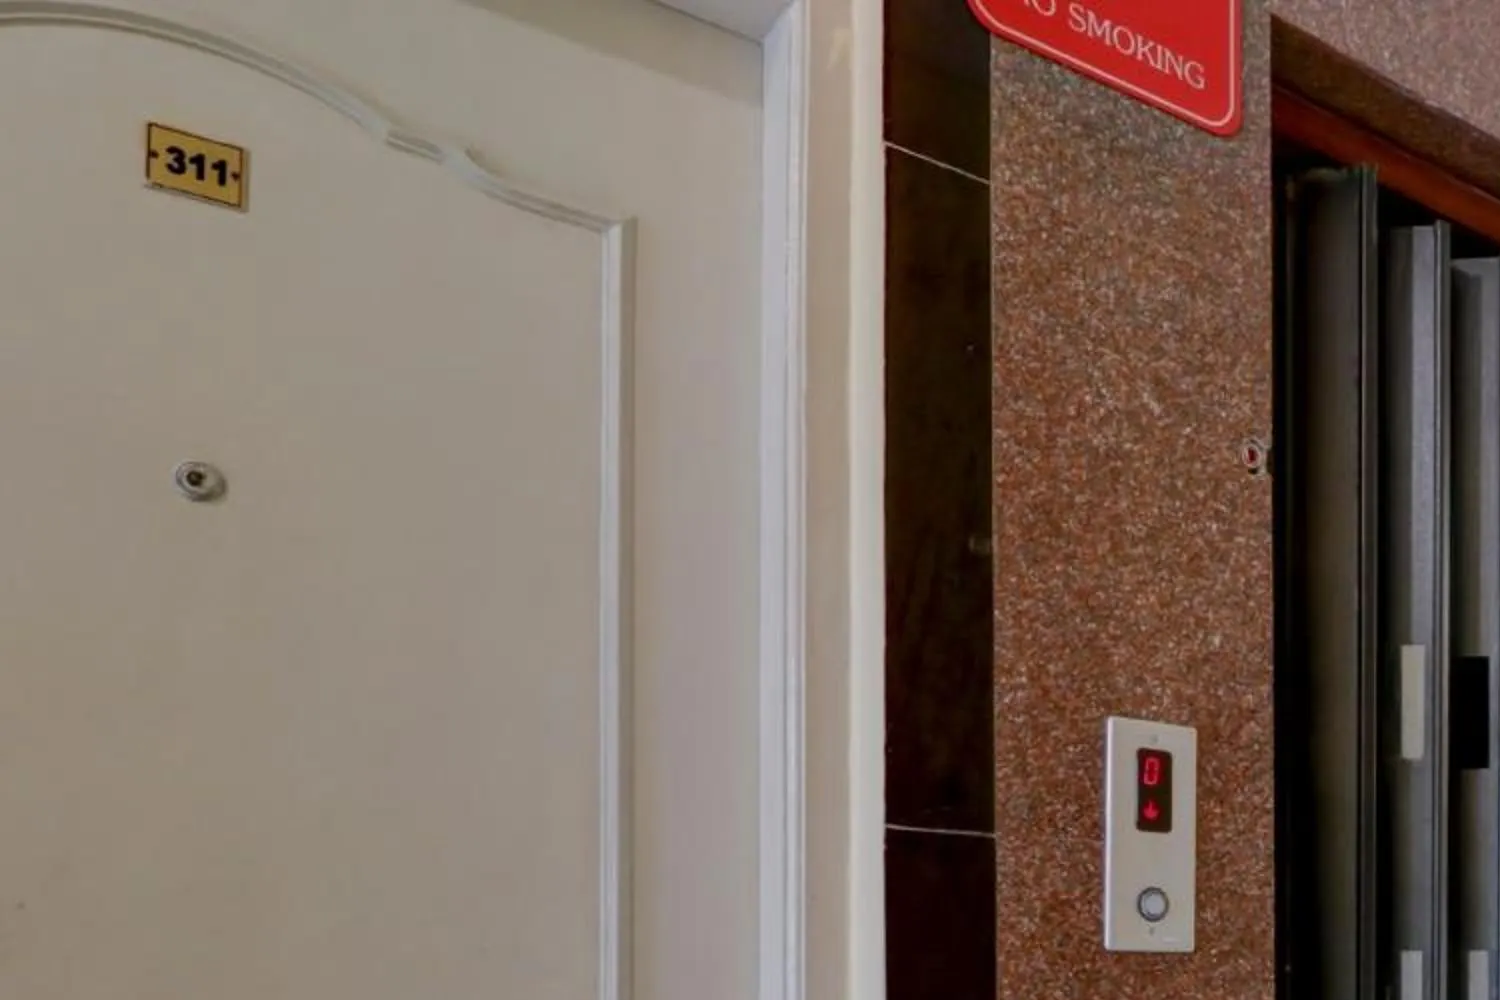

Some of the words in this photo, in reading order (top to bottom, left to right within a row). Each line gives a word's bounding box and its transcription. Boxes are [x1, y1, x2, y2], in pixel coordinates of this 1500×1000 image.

[1024, 0, 1057, 16] O
[1068, 3, 1206, 90] SMOKING
[165, 145, 227, 187] 311
